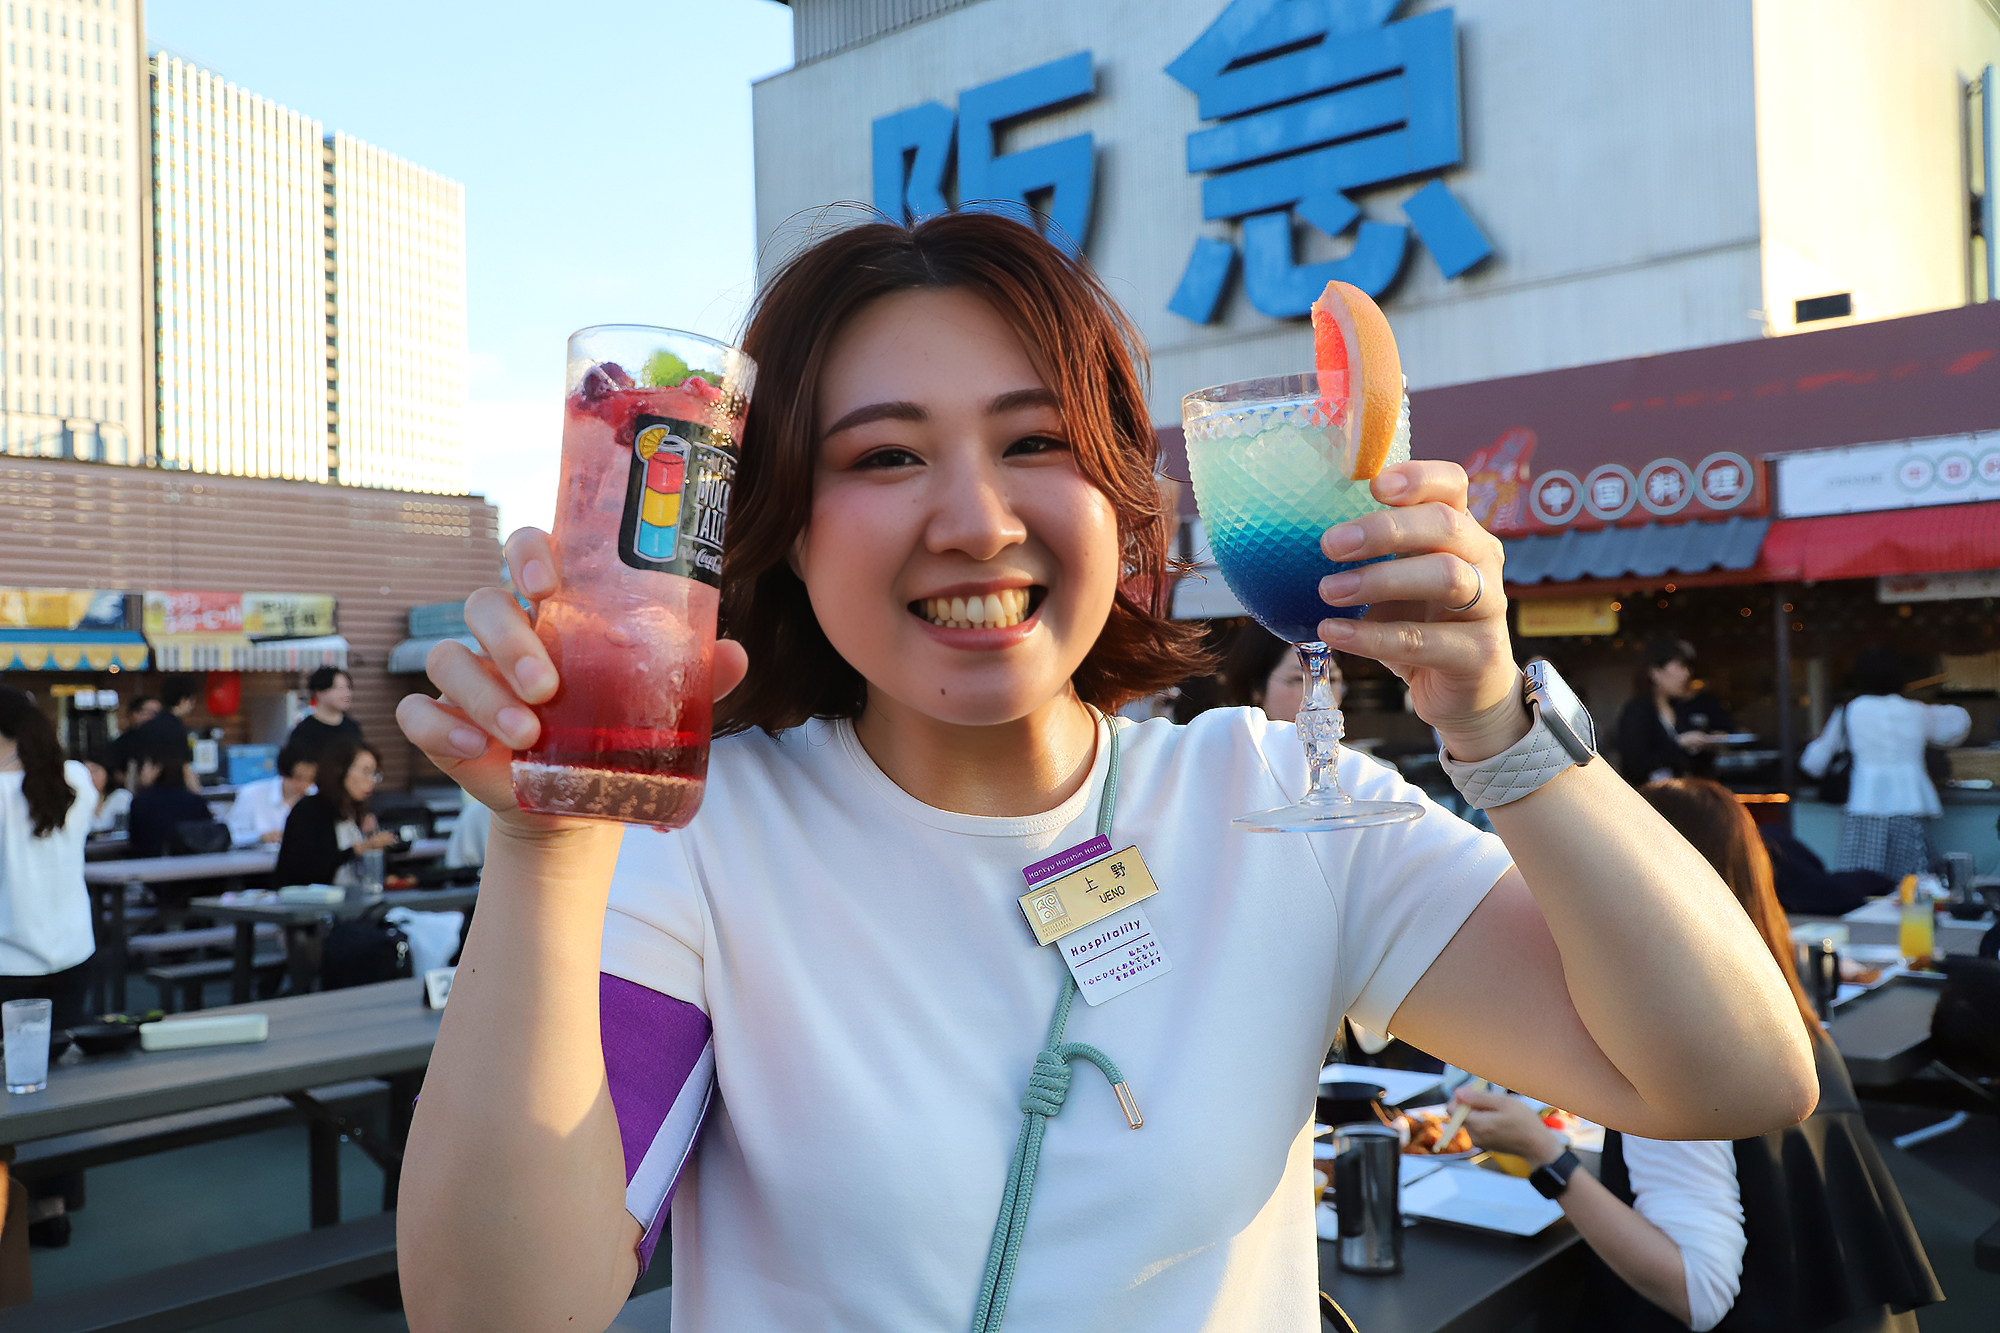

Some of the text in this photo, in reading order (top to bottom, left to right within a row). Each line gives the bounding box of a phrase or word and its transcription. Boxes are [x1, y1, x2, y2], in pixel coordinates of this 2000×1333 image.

[873, 0, 1491, 324] 阪急
[1540, 465, 1741, 514] 中国料理
[1027, 841, 1108, 880] Hankyu Hanshin Hotels
[1099, 885, 1126, 904] UENO
[1070, 918, 1142, 957] Hospitality
[1128, 941, 1156, 957] 私たちは
[1083, 950, 1160, 986] 「心にひびくおもてなし」
[1115, 956, 1162, 982] をお届けします
